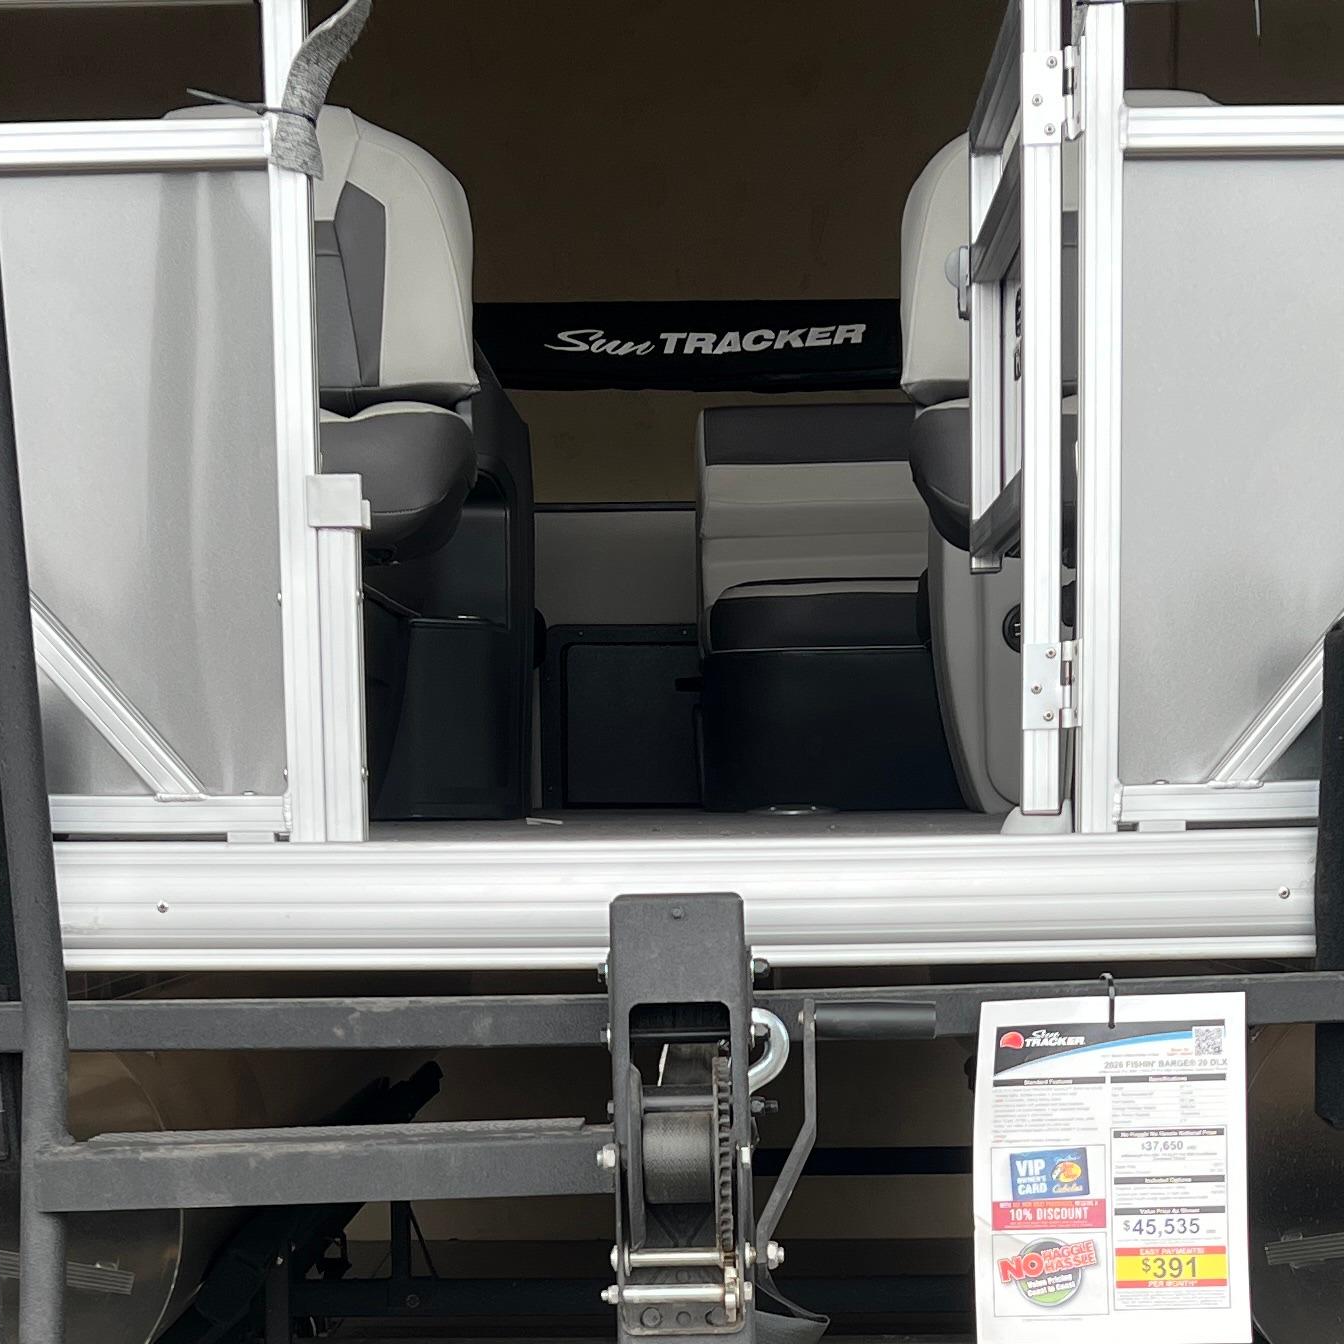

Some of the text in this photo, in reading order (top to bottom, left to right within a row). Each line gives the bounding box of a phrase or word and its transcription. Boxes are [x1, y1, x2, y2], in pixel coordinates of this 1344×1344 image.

[544, 324, 866, 355] Sun TRACKER
[1024, 1036, 1086, 1048] TRACKER
[1141, 1140, 1184, 1152] $37,650
[1015, 1159, 1045, 1176] VIP
[1017, 1182, 1048, 1195] CARD
[1009, 1207, 1088, 1221] 10% DISCOUNT
[1123, 1218, 1200, 1237] $45,535
[1041, 1240, 1094, 1261] HAGGLE
[997, 1252, 1044, 1283] NO
[1044, 1253, 1097, 1274] HASSLE
[1142, 1256, 1197, 1279] $391
